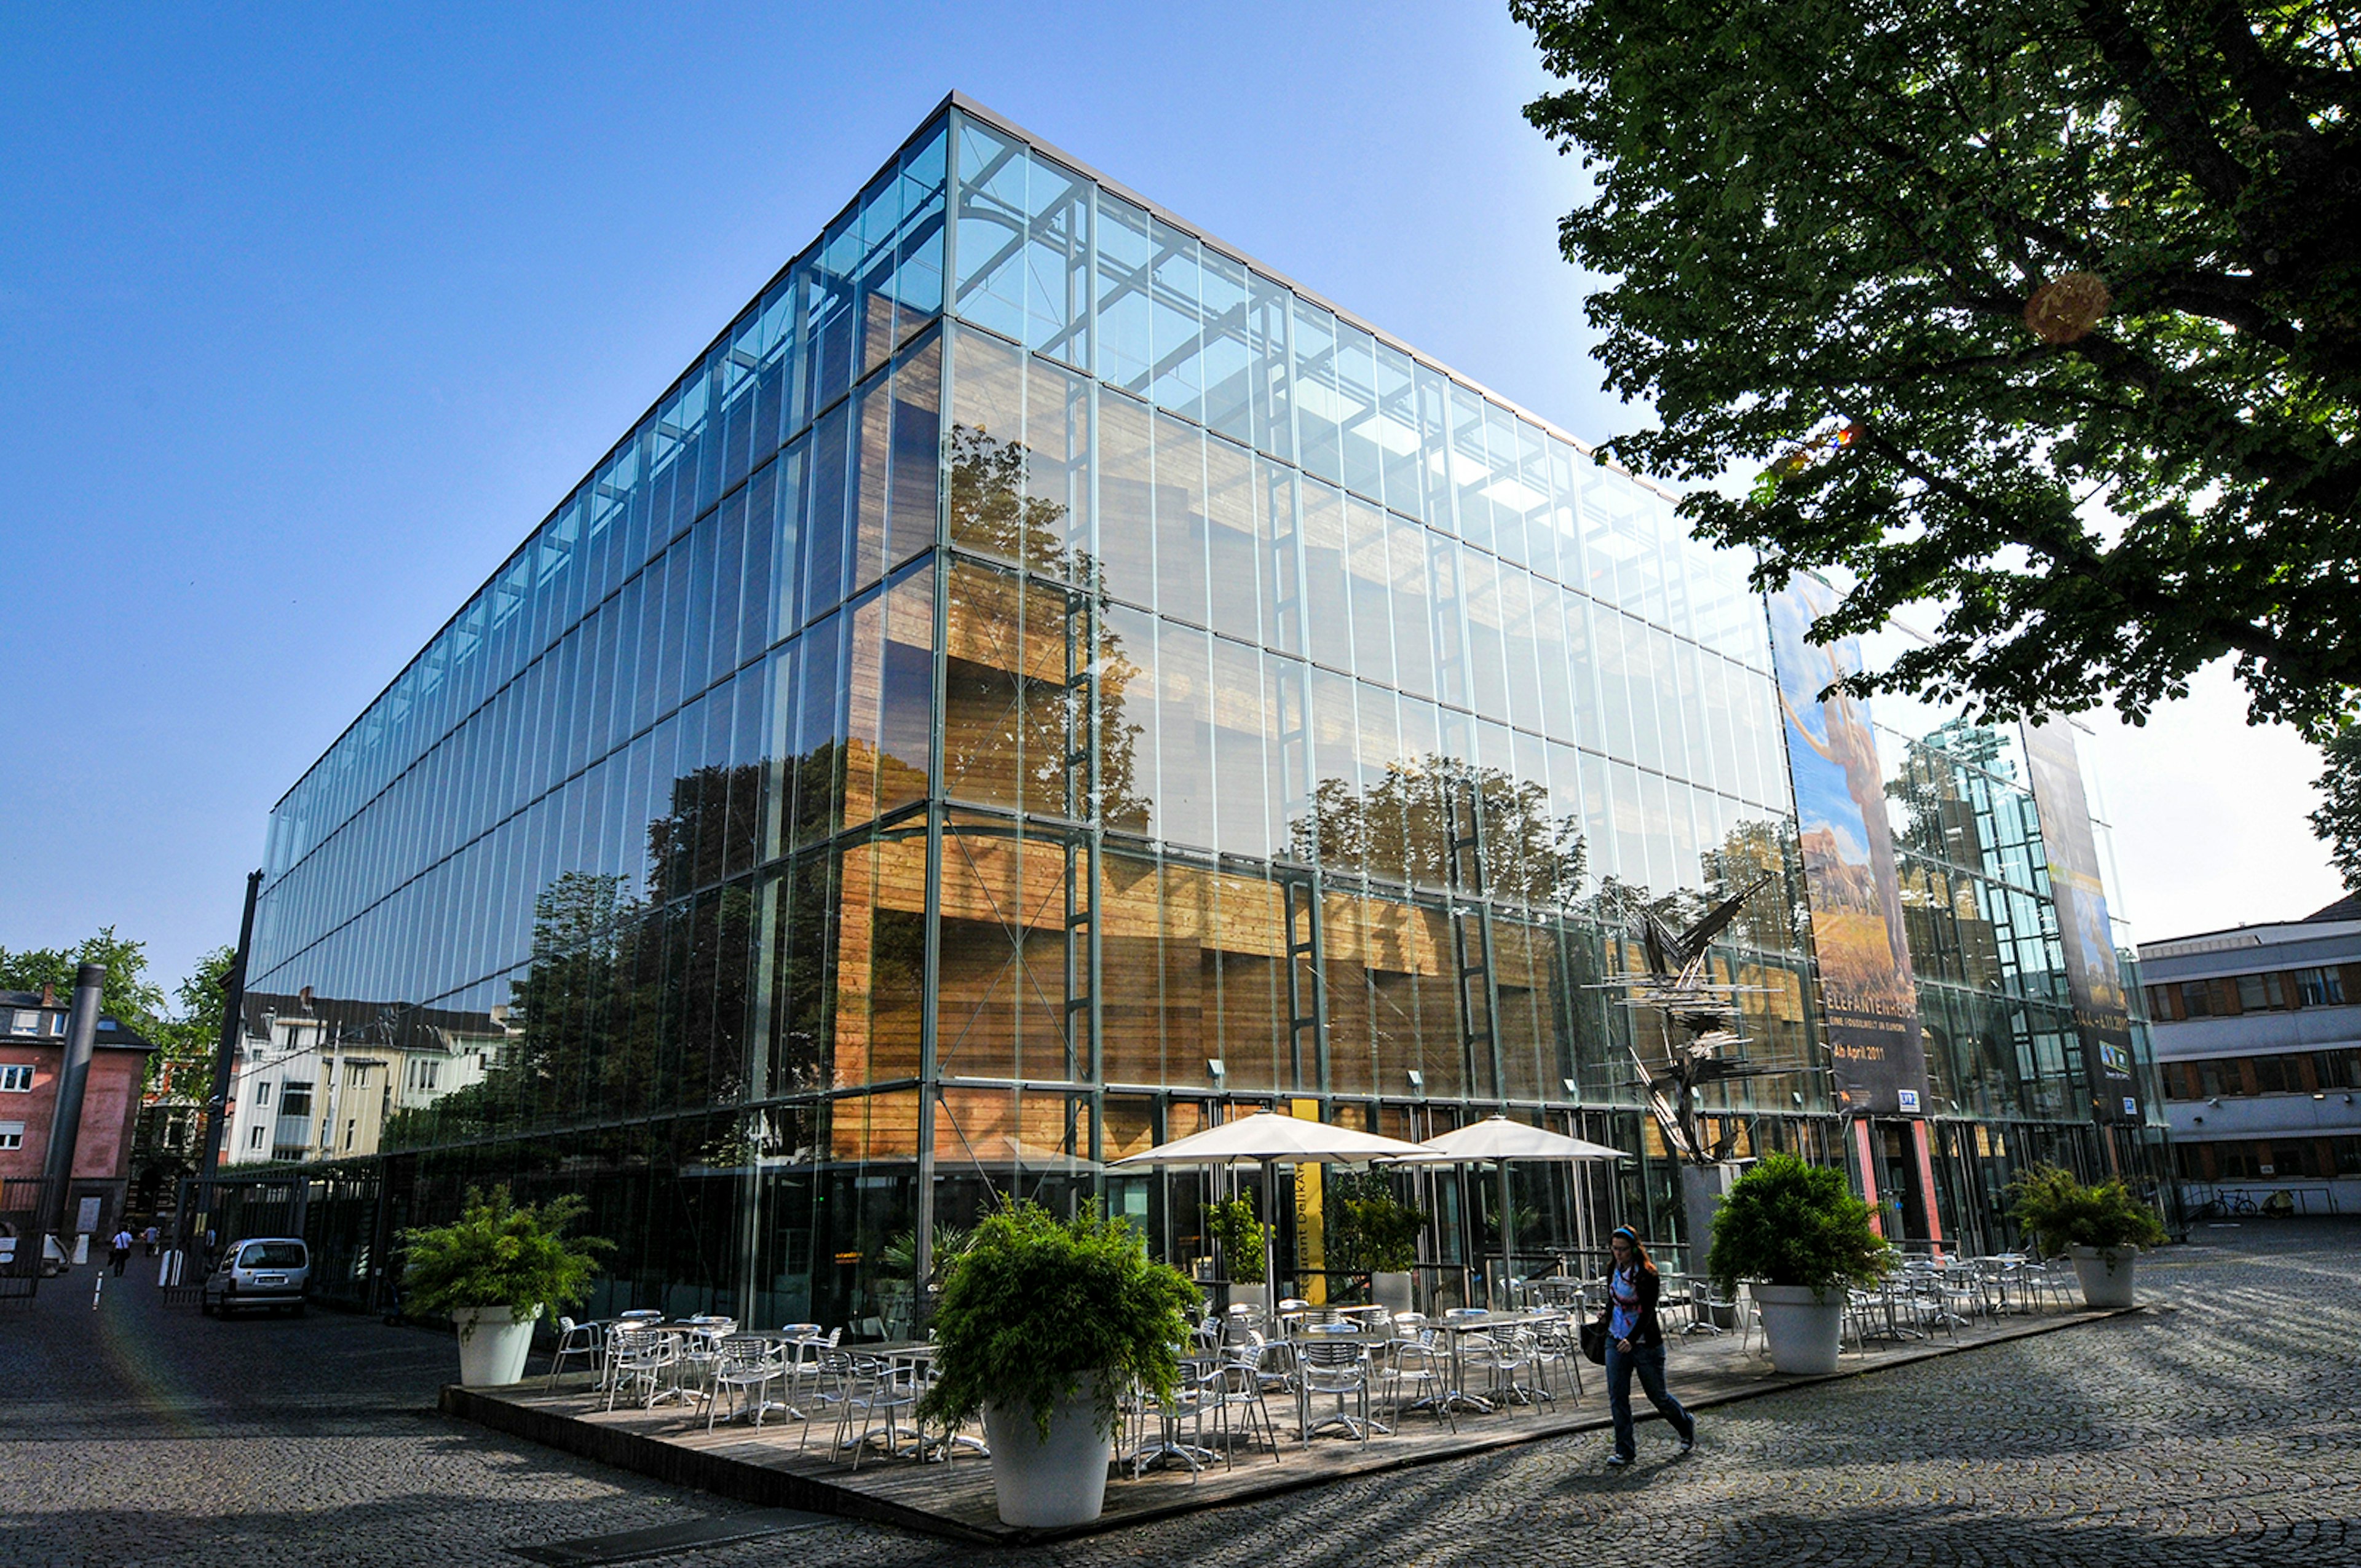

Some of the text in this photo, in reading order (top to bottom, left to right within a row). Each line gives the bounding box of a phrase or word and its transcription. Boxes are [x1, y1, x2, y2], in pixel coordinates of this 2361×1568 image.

[1826, 991, 1917, 1020] ELEFANTENREICH
[1878, 1021, 1886, 1031] IN
[1833, 1043, 1885, 1063] Ab April 2011
